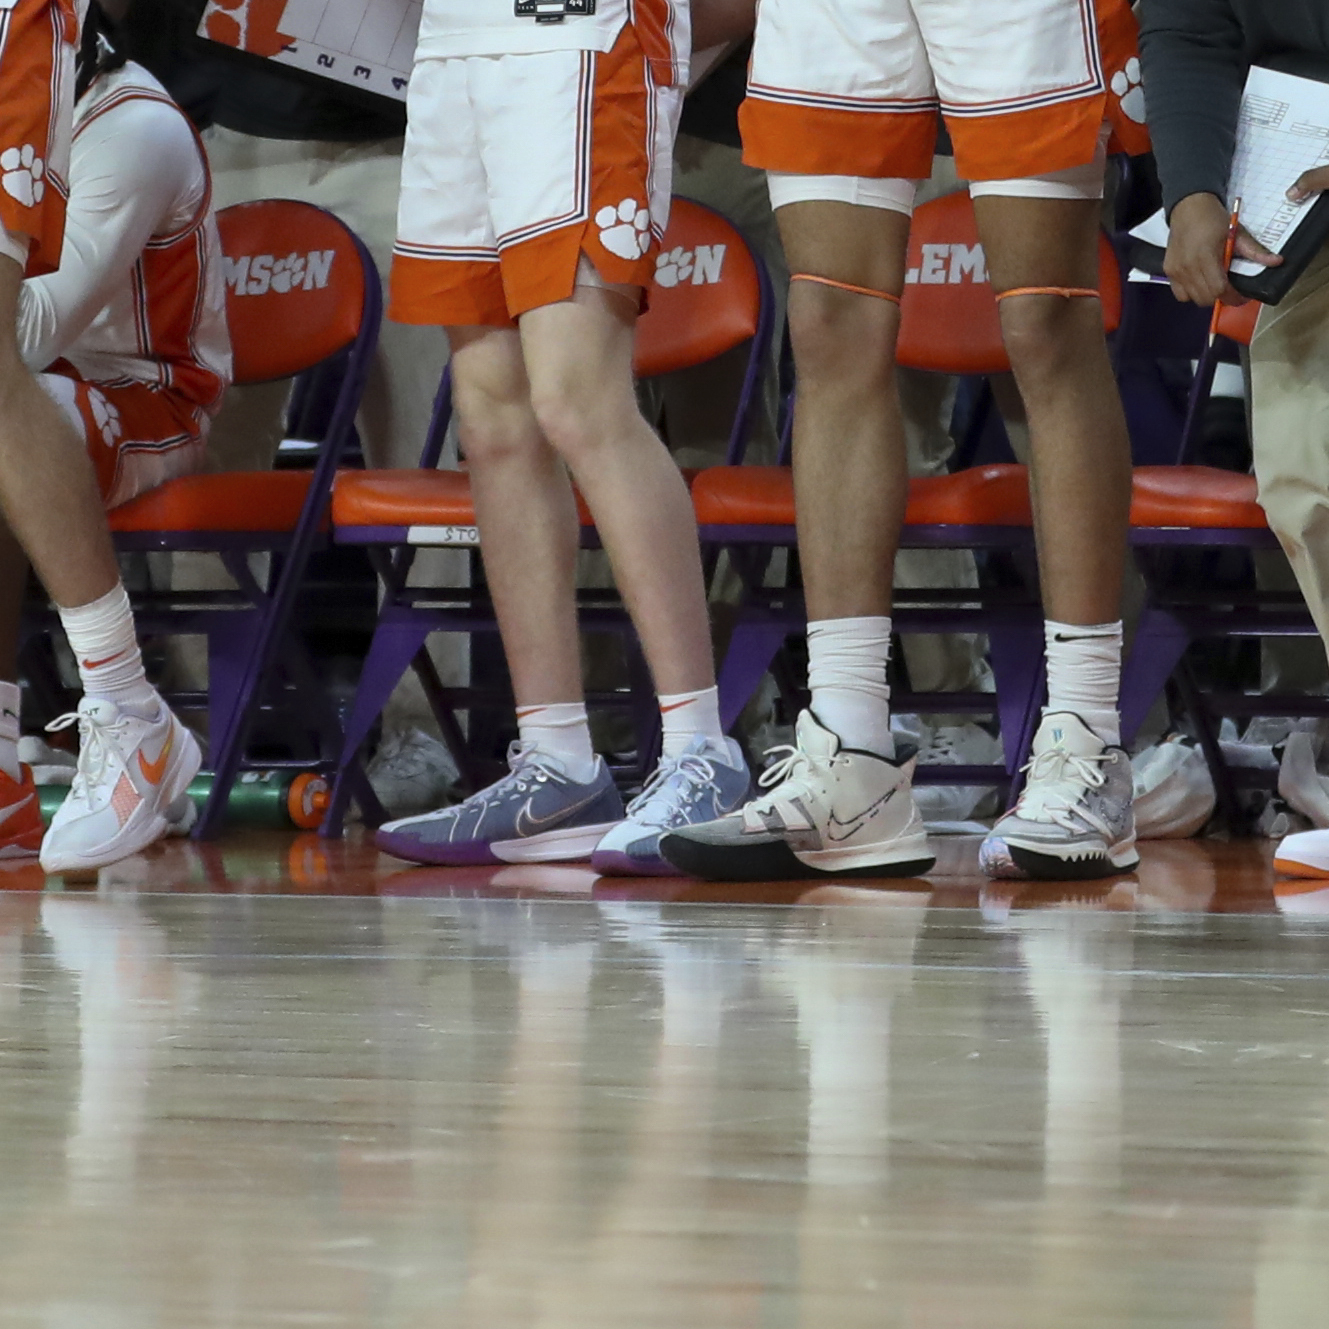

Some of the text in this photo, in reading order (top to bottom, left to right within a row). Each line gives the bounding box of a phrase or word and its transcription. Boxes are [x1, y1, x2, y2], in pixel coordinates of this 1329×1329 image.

[317, 53, 335, 69] 2
[354, 65, 371, 79] 3
[391, 75, 408, 91] 4
